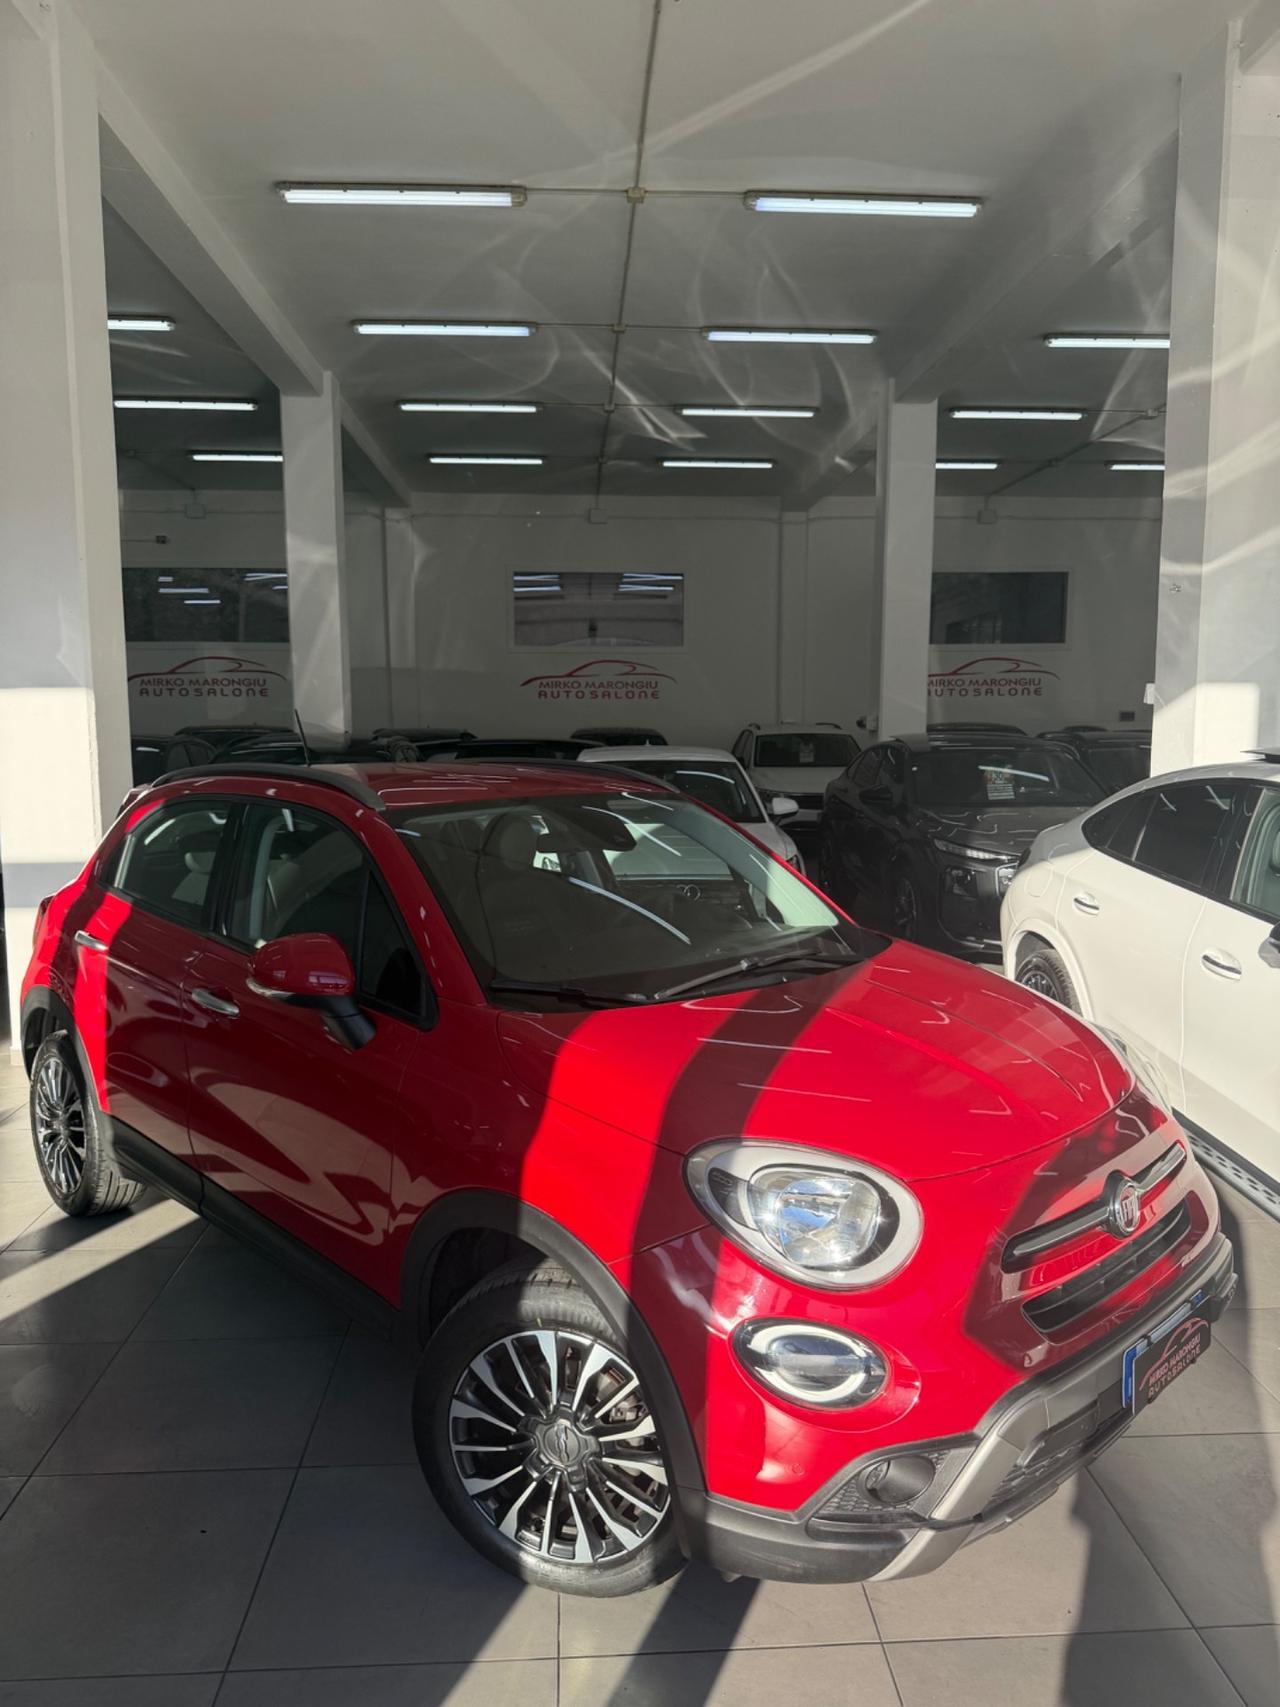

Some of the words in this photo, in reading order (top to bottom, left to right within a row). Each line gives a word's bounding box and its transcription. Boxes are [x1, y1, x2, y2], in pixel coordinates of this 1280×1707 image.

[139, 678, 185, 687] MIRKO
[188, 678, 267, 687] MARONGIU
[538, 680, 582, 689] MIRKO
[585, 680, 658, 689] MARONGIU
[968, 678, 1042, 687] MARONGIU
[139, 687, 269, 697] AUTOSALONE
[538, 690, 660, 700] AUTOSALONE
[928, 687, 1043, 697] UTOSALONE
